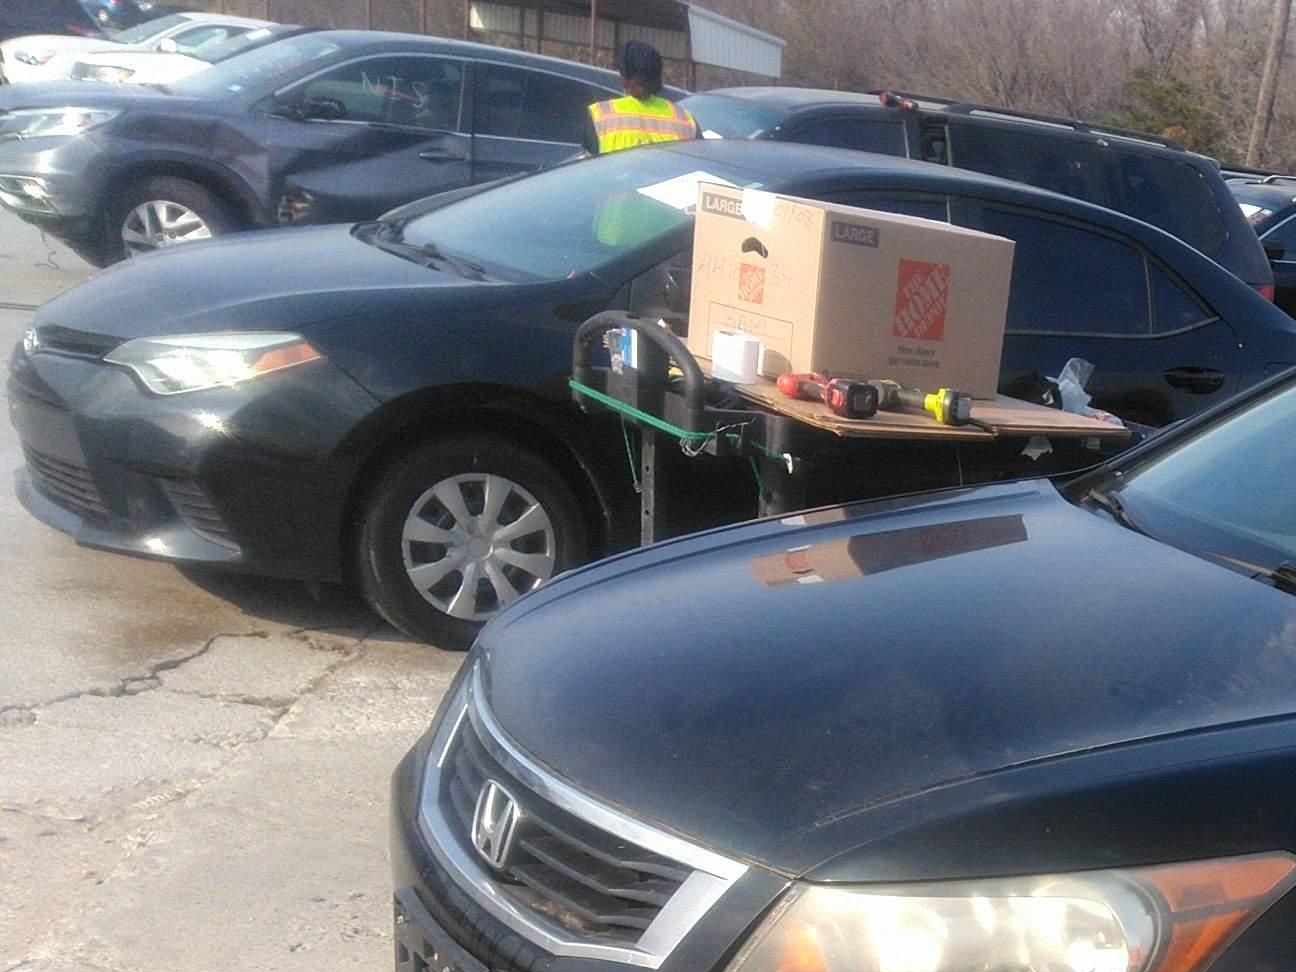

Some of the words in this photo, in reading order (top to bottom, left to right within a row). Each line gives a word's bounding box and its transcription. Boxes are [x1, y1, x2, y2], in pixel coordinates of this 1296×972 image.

[706, 195, 743, 216] LARGE
[834, 225, 875, 243] LARGE
[893, 264, 949, 338] HOME
